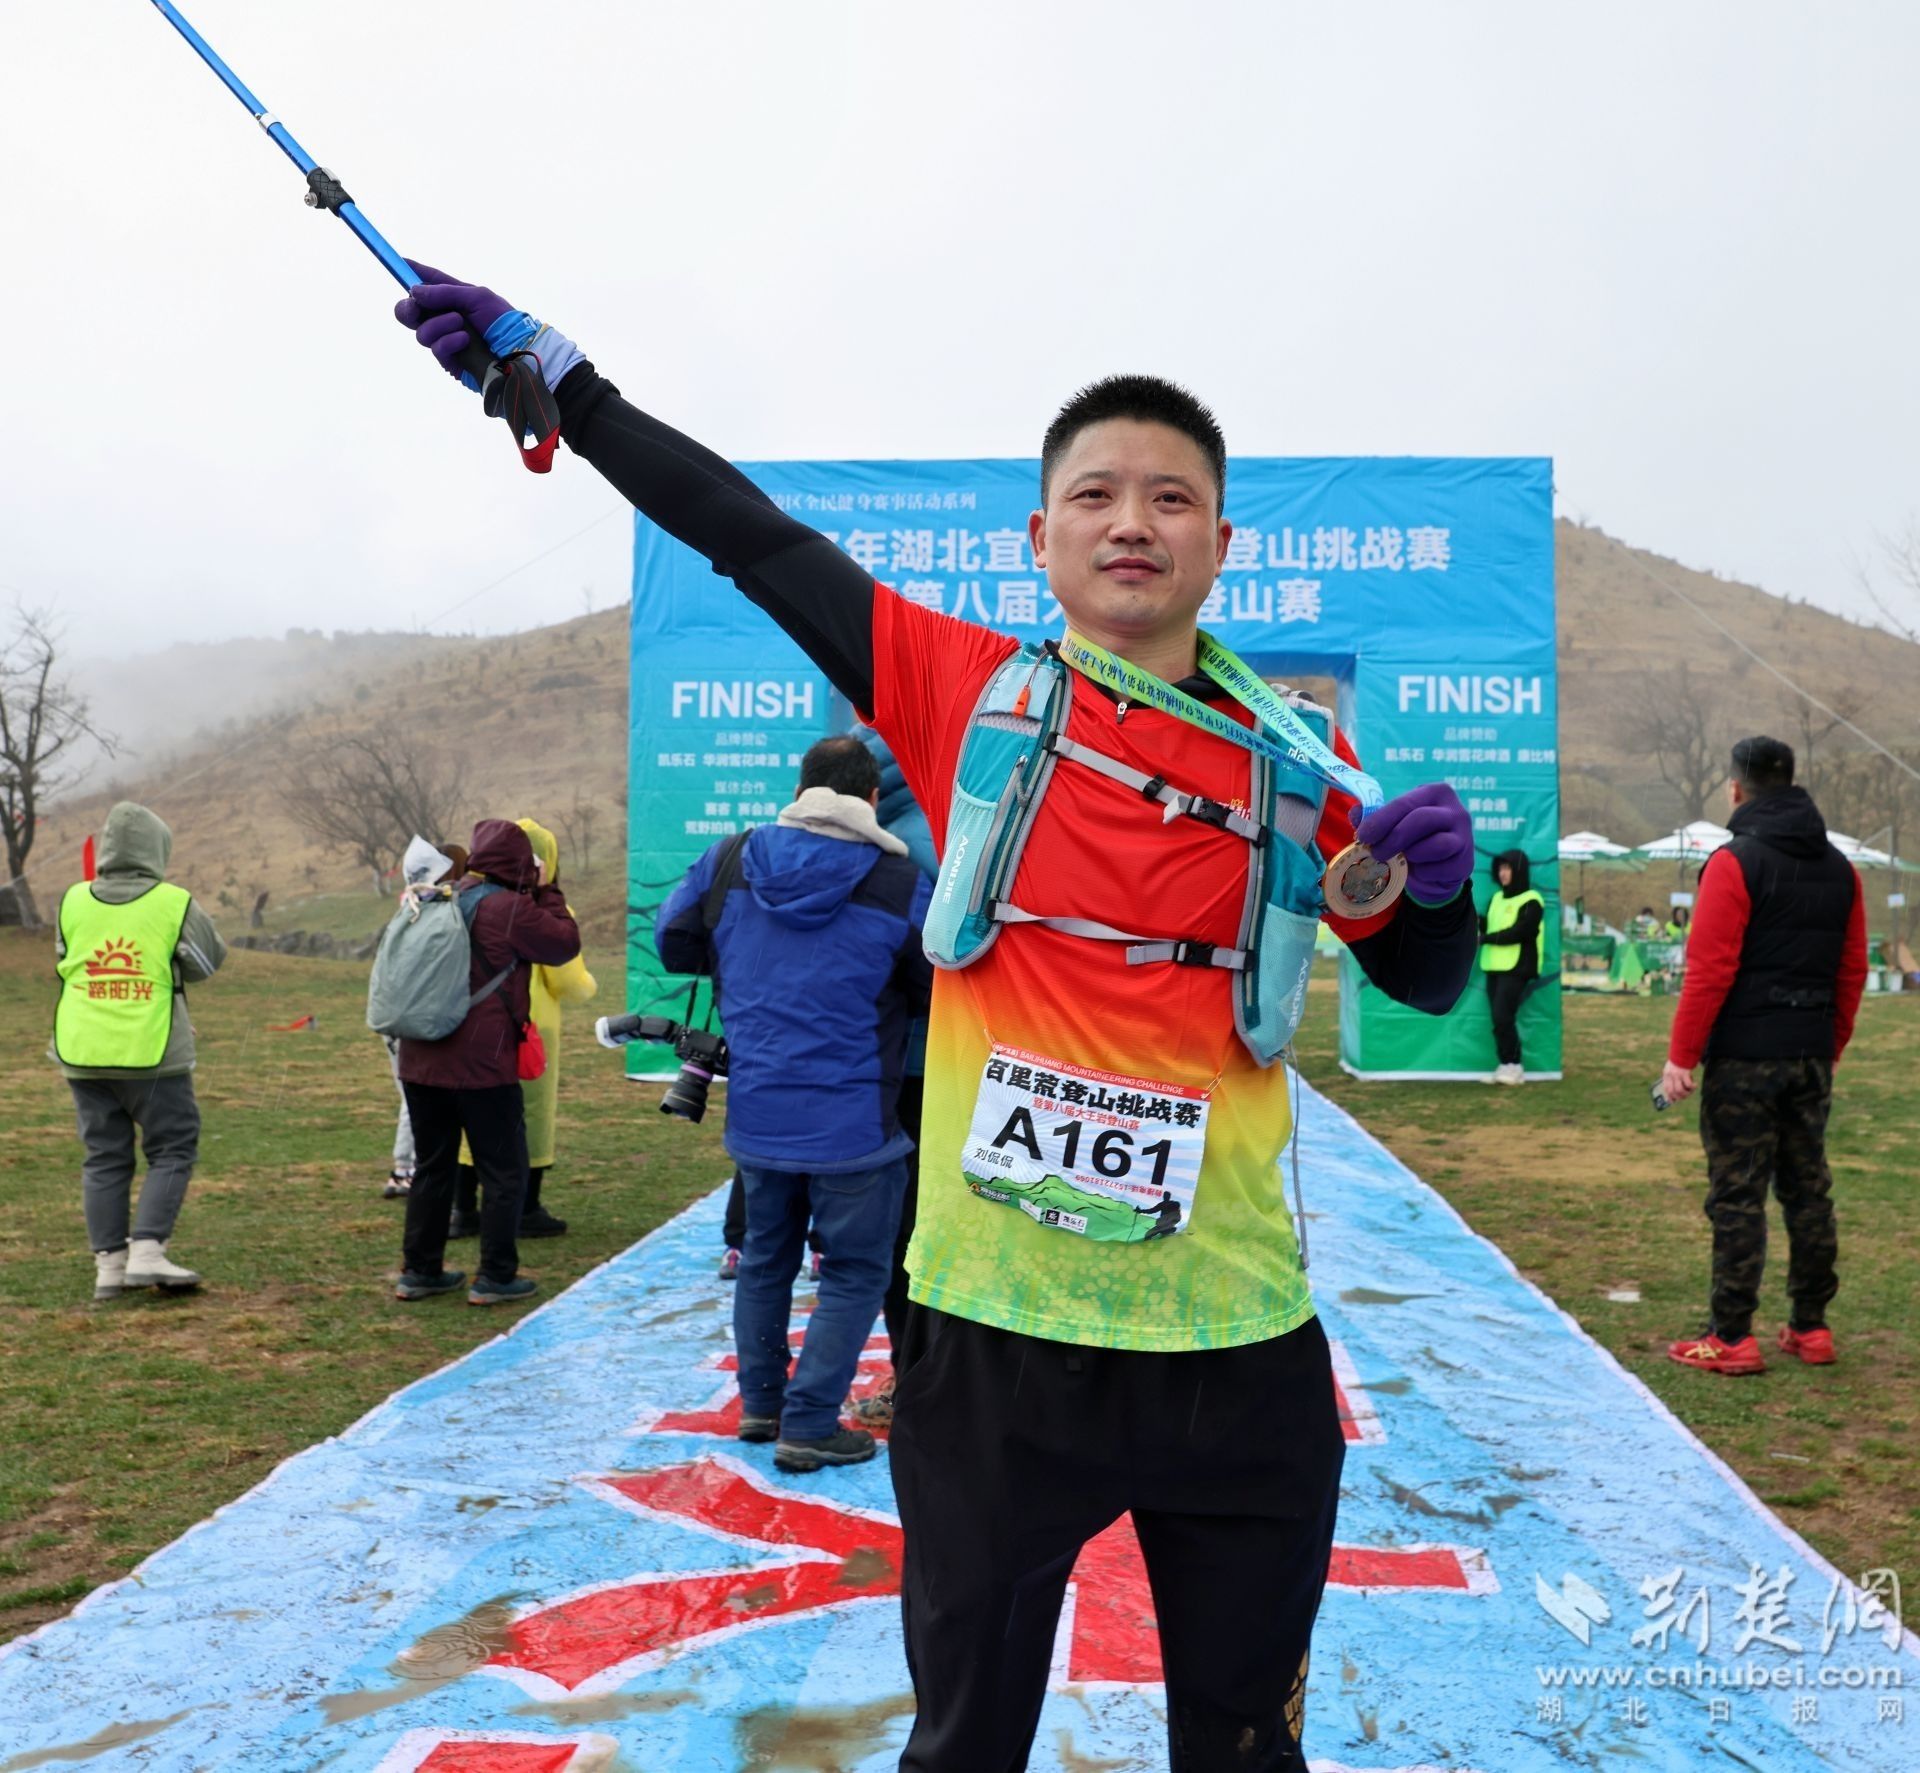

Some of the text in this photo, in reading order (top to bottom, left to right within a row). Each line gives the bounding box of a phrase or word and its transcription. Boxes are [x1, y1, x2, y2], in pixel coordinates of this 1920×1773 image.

[823, 526, 1451, 573] 年湖北宜 登山挑战赛
[1197, 578, 1322, 624] 登山赛
[672, 681, 814, 719] FINISH
[1398, 675, 1542, 714] FINISH
[943, 835, 970, 905] AONIJIE
[73, 980, 154, 1001] 一路阳光
[986, 1058, 1202, 1128] 百里荒登山挑战赛
[1063, 1061, 1136, 1086] MOUNTAINEERING
[1135, 1078, 1185, 1095] CHALLENGE
[974, 1147, 1014, 1169] 刘侃侃
[991, 1105, 1172, 1186] A161
